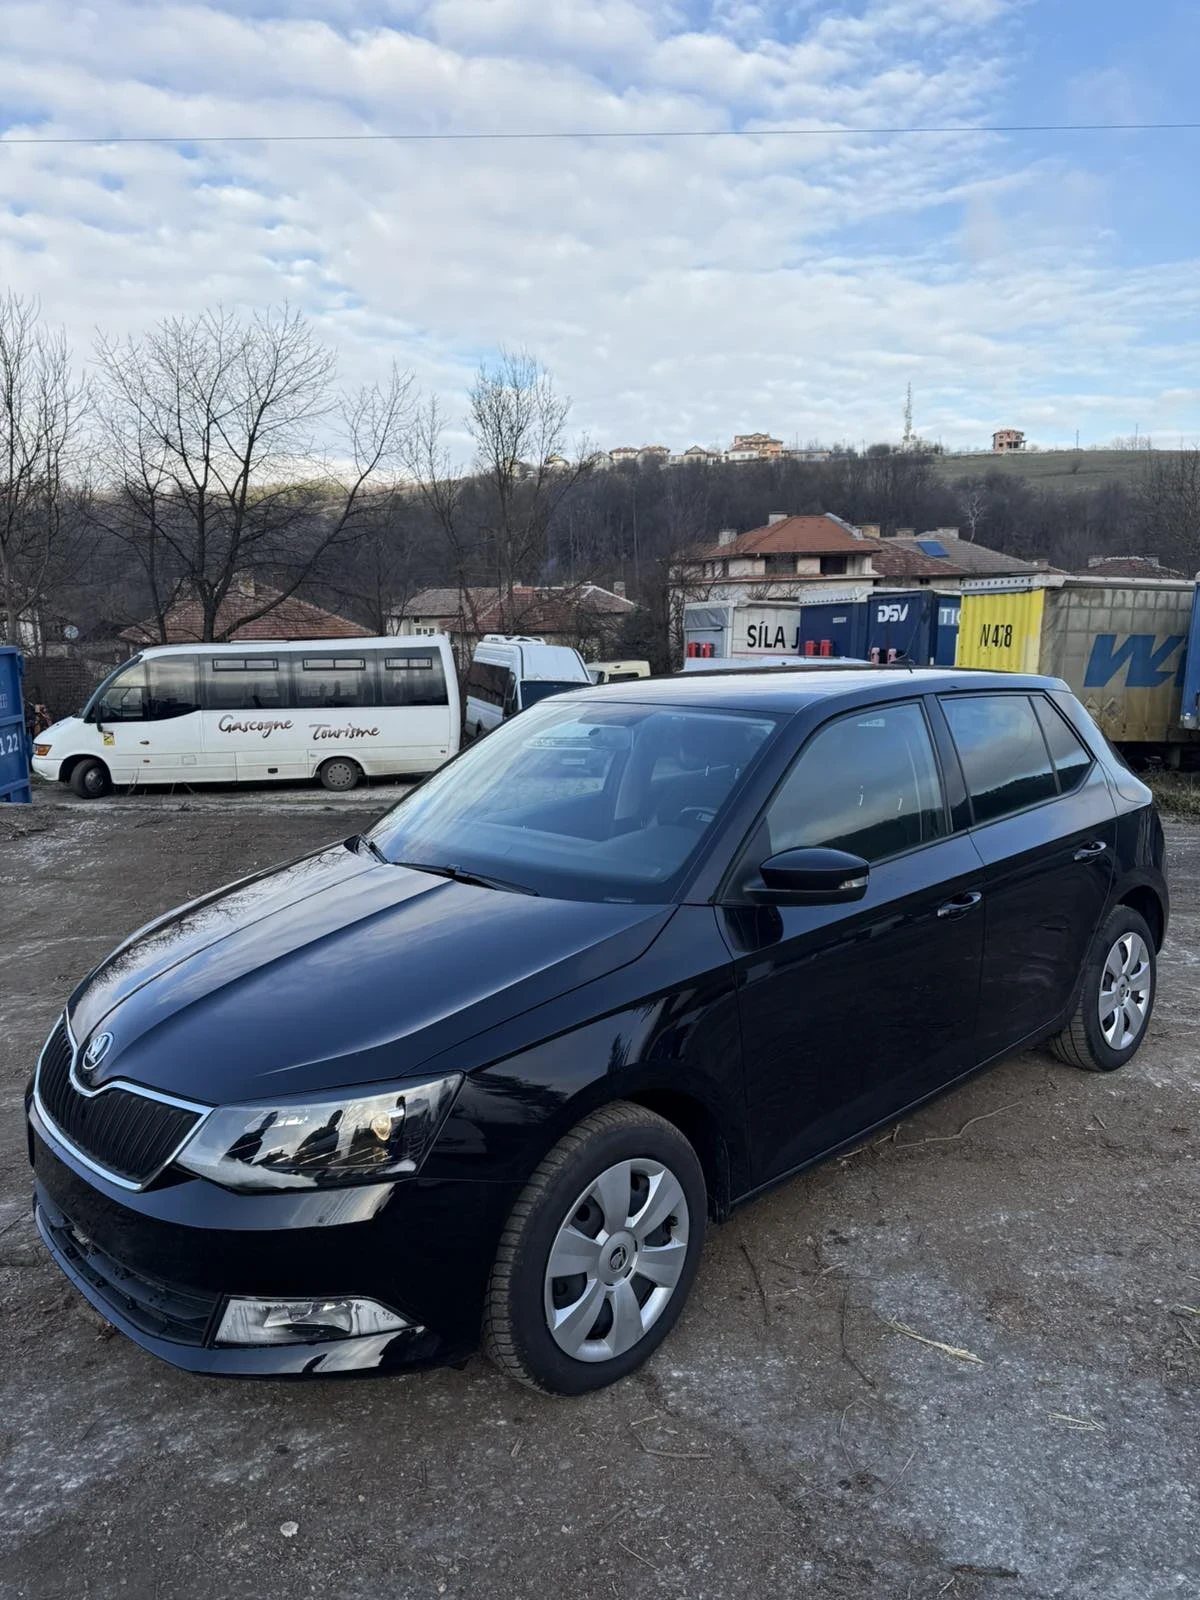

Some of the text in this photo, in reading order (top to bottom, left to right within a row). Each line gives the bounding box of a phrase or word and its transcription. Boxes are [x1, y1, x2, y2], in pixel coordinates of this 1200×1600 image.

[878, 604, 909, 623] DSV
[940, 608, 961, 625] TI
[747, 620, 786, 648] SÍLA
[218, 714, 380, 740] Gascogne Tourisme
